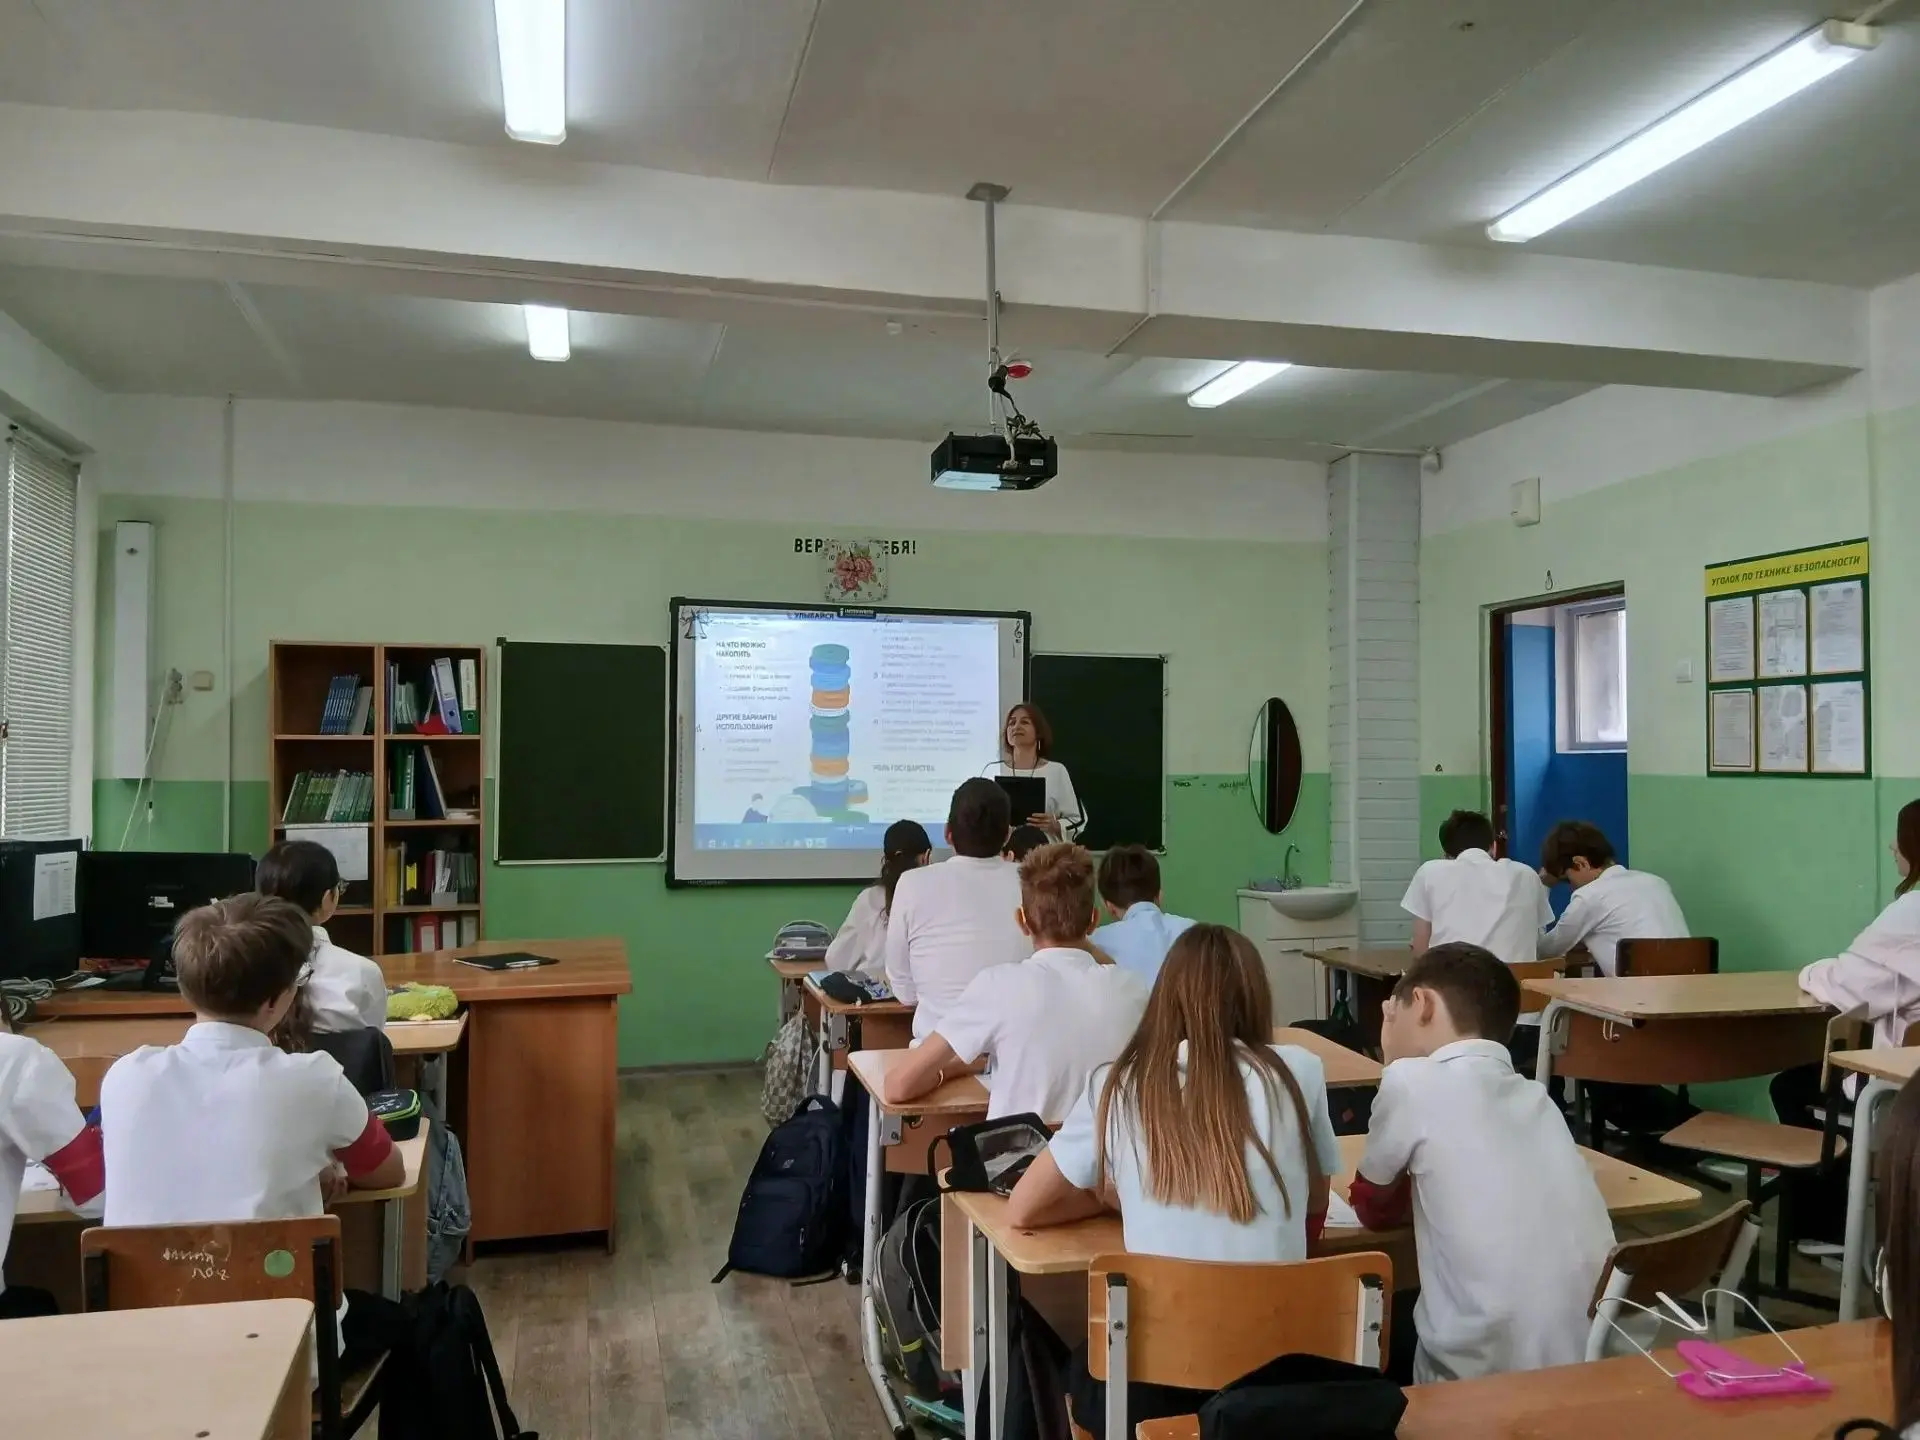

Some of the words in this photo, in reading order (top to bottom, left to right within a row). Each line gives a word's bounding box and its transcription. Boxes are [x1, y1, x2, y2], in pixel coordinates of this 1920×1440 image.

[794, 538, 824, 553] ВЕР
[1711, 573, 1740, 586] УГОЛОК
[1741, 572, 1753, 583] ПО
[1755, 567, 1791, 580] ТЕХНИКЕ
[1793, 555, 1861, 573] БЕЗОПАСНОСТИ
[715, 641, 725, 649] НА
[726, 641, 740, 649] ЧТО
[740, 641, 766, 649] МОЖНО
[715, 650, 751, 658] НАКОПИТЬ
[716, 713, 741, 721] ДРУГИЕ
[742, 713, 777, 721] ВАРИАНТЫ
